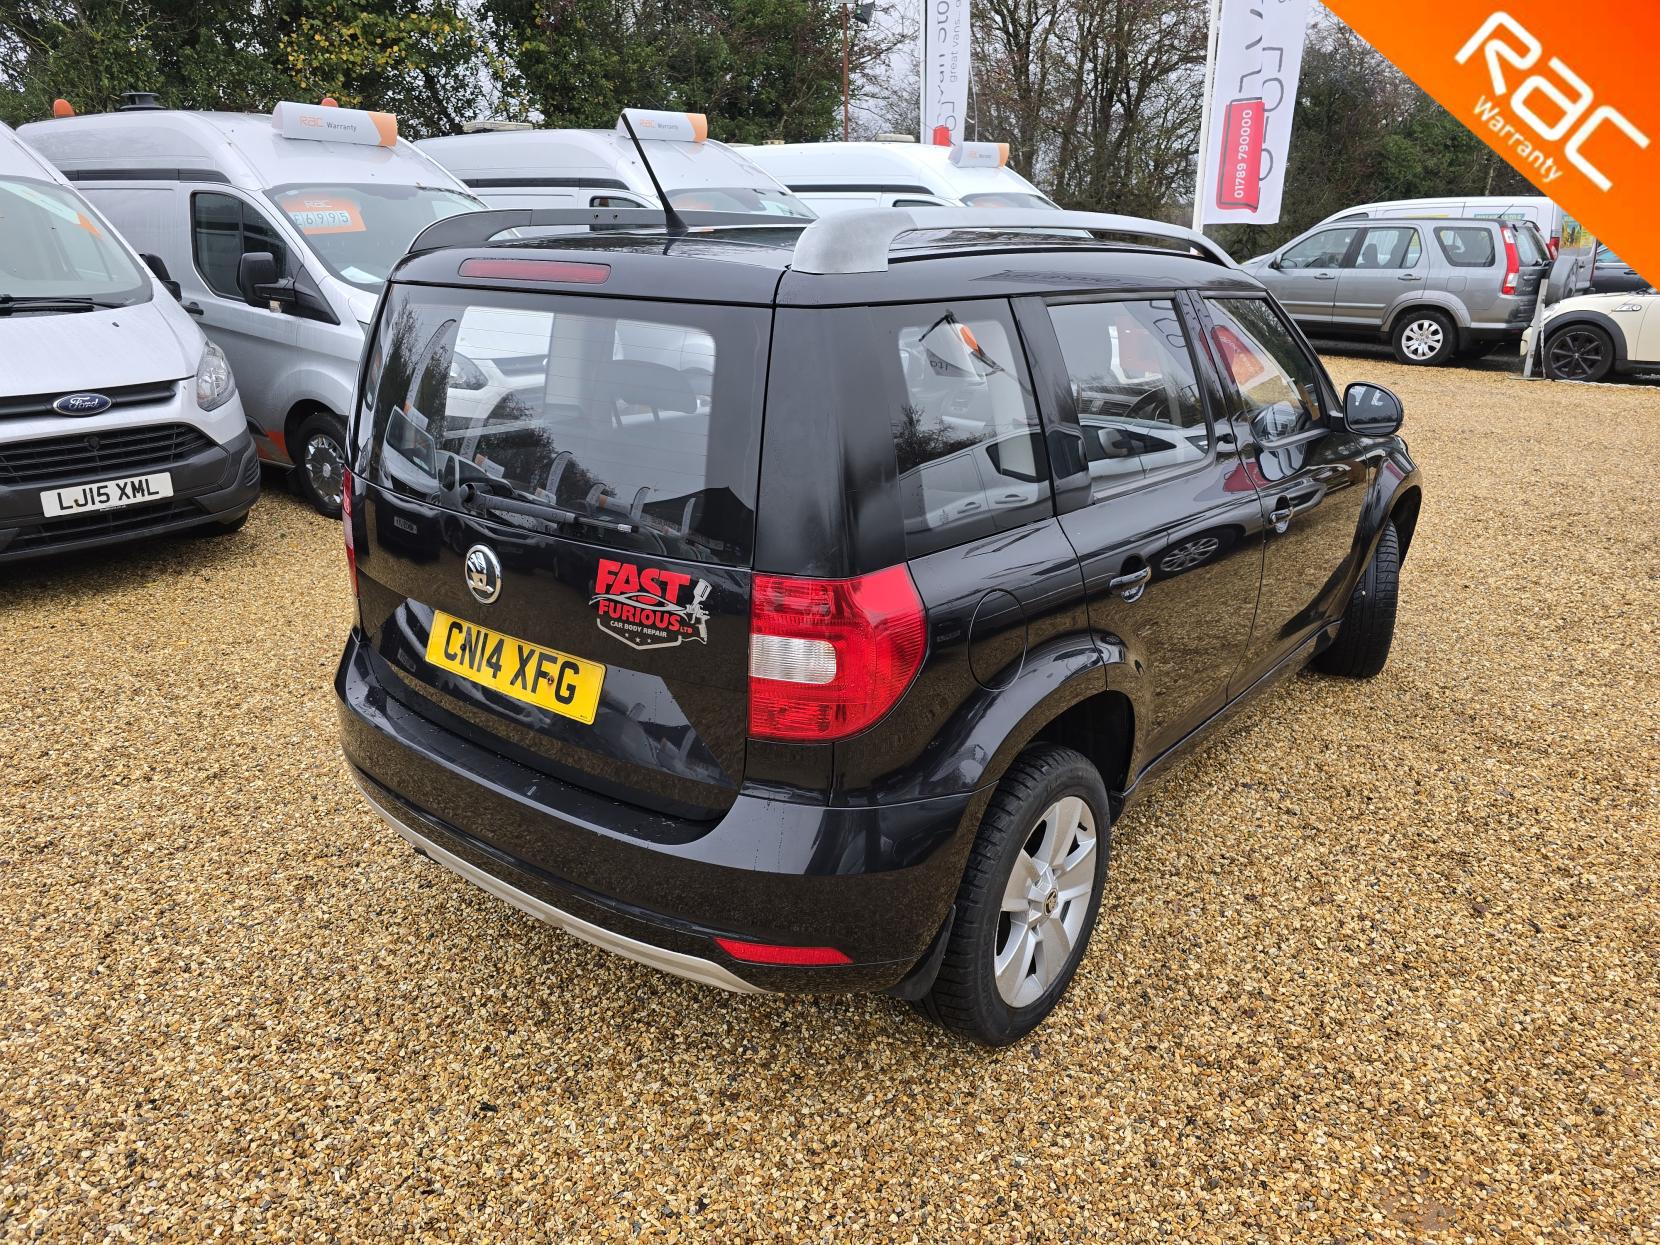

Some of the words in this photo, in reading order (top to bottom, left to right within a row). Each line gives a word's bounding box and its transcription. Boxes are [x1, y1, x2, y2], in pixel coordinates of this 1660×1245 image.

[950, 51, 958, 83] great
[327, 121, 357, 132] Warranty
[1238, 110, 1252, 160] 790000
[1234, 162, 1248, 198] 01789
[69, 396, 99, 410] Ford
[57, 485, 110, 510] LJ15
[116, 478, 159, 501] XML
[595, 558, 691, 605] FAST
[598, 600, 681, 631] FURIOUS
[680, 626, 693, 634] LTD
[610, 620, 623, 629] CAR
[624, 623, 642, 633] BODY
[643, 627, 667, 637] REPAIR
[444, 621, 504, 679] CN14
[510, 644, 580, 705] XFG
